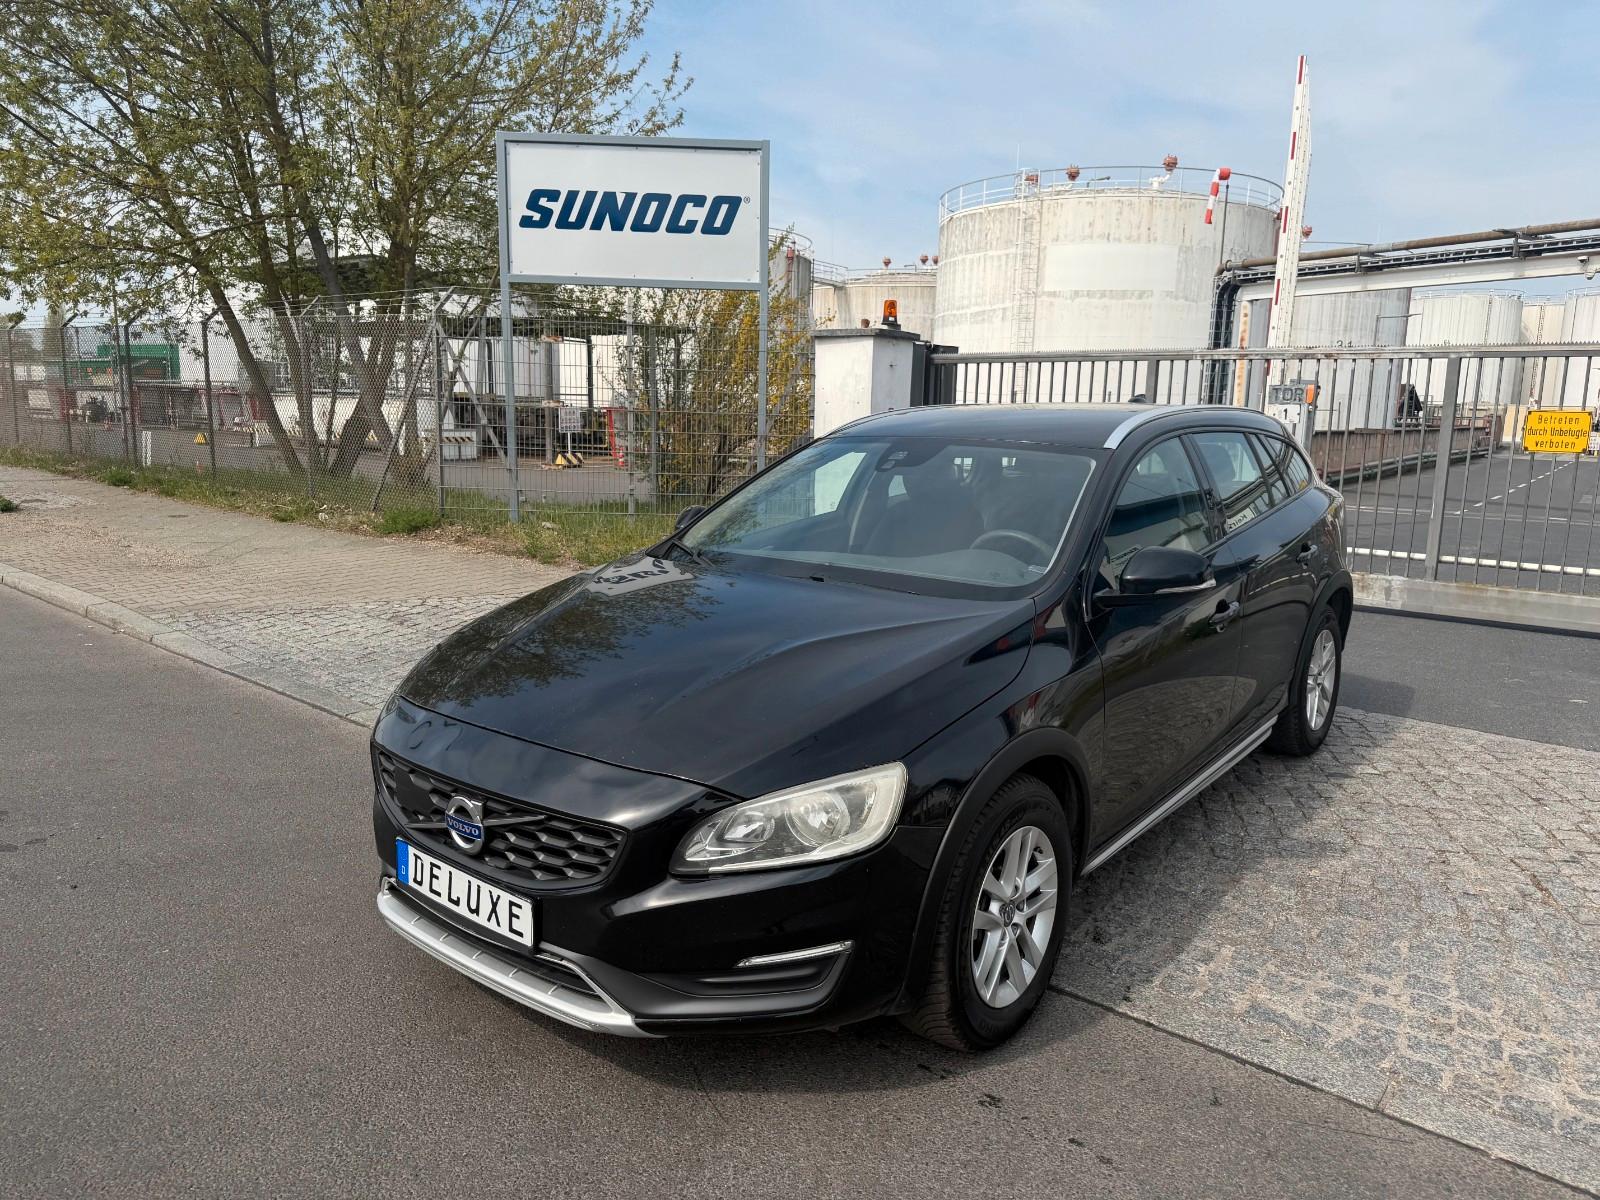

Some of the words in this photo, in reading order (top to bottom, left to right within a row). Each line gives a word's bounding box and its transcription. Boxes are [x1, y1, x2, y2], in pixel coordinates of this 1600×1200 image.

[518, 188, 743, 236] SUNOCO
[1272, 387, 1304, 402] TOR
[1283, 407, 1288, 420] 1
[1537, 414, 1580, 425] Betreten
[1527, 426, 1548, 436] durch
[1550, 426, 1588, 440] Unbefugte
[1535, 439, 1576, 450] verboten
[447, 817, 480, 837] VOLVO
[412, 852, 524, 938] DELUXE
